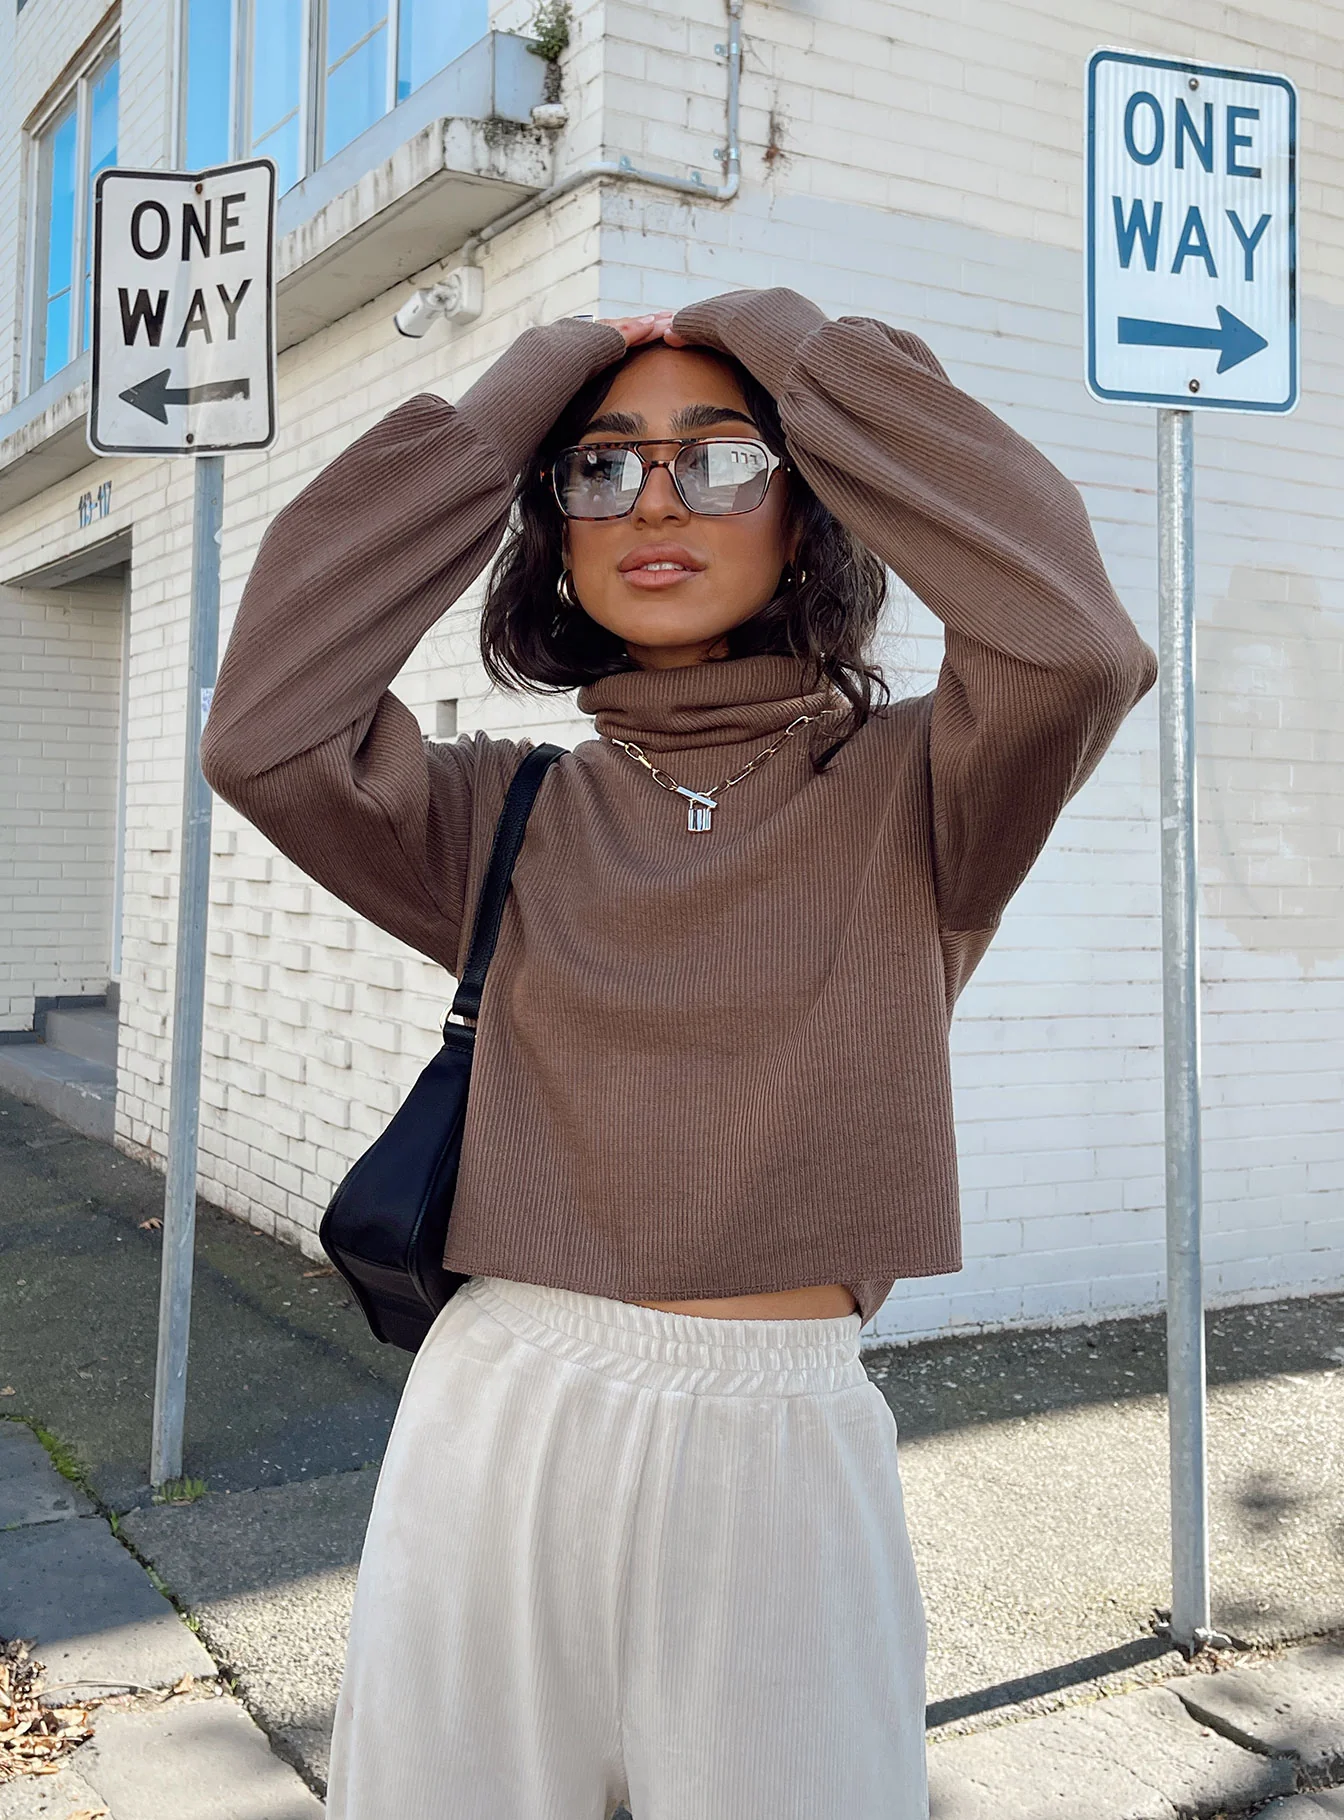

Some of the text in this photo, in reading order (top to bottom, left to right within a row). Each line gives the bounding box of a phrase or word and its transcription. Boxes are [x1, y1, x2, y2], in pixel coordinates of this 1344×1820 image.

[1123, 90, 1262, 179] ONE
[130, 192, 246, 261] ONE
[1111, 195, 1273, 282] WAY
[117, 278, 253, 348] WAY
